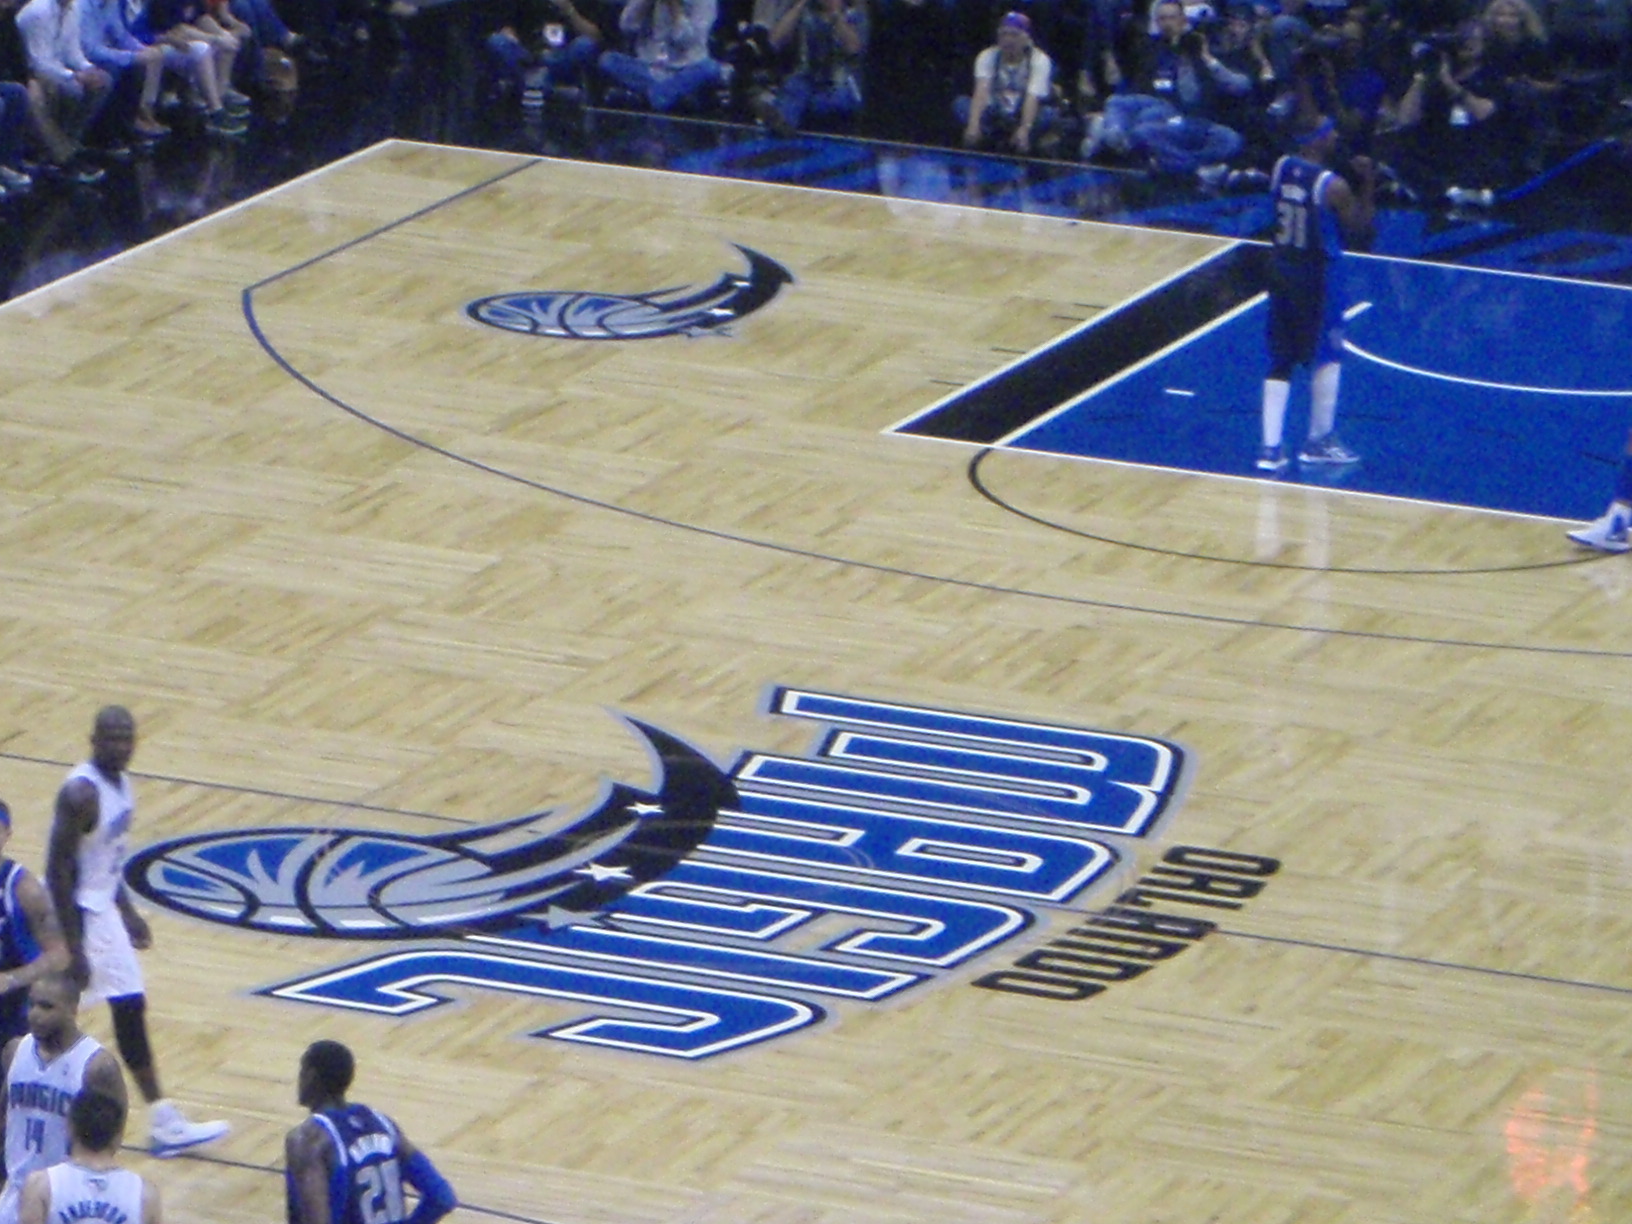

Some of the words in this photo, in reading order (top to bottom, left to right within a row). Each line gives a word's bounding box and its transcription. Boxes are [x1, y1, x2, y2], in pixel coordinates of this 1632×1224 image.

[1274, 200, 1308, 248] 31
[254, 686, 1184, 1062] MAGIC
[971, 845, 1281, 1001] ORLANDO
[24, 1116, 46, 1155] 14
